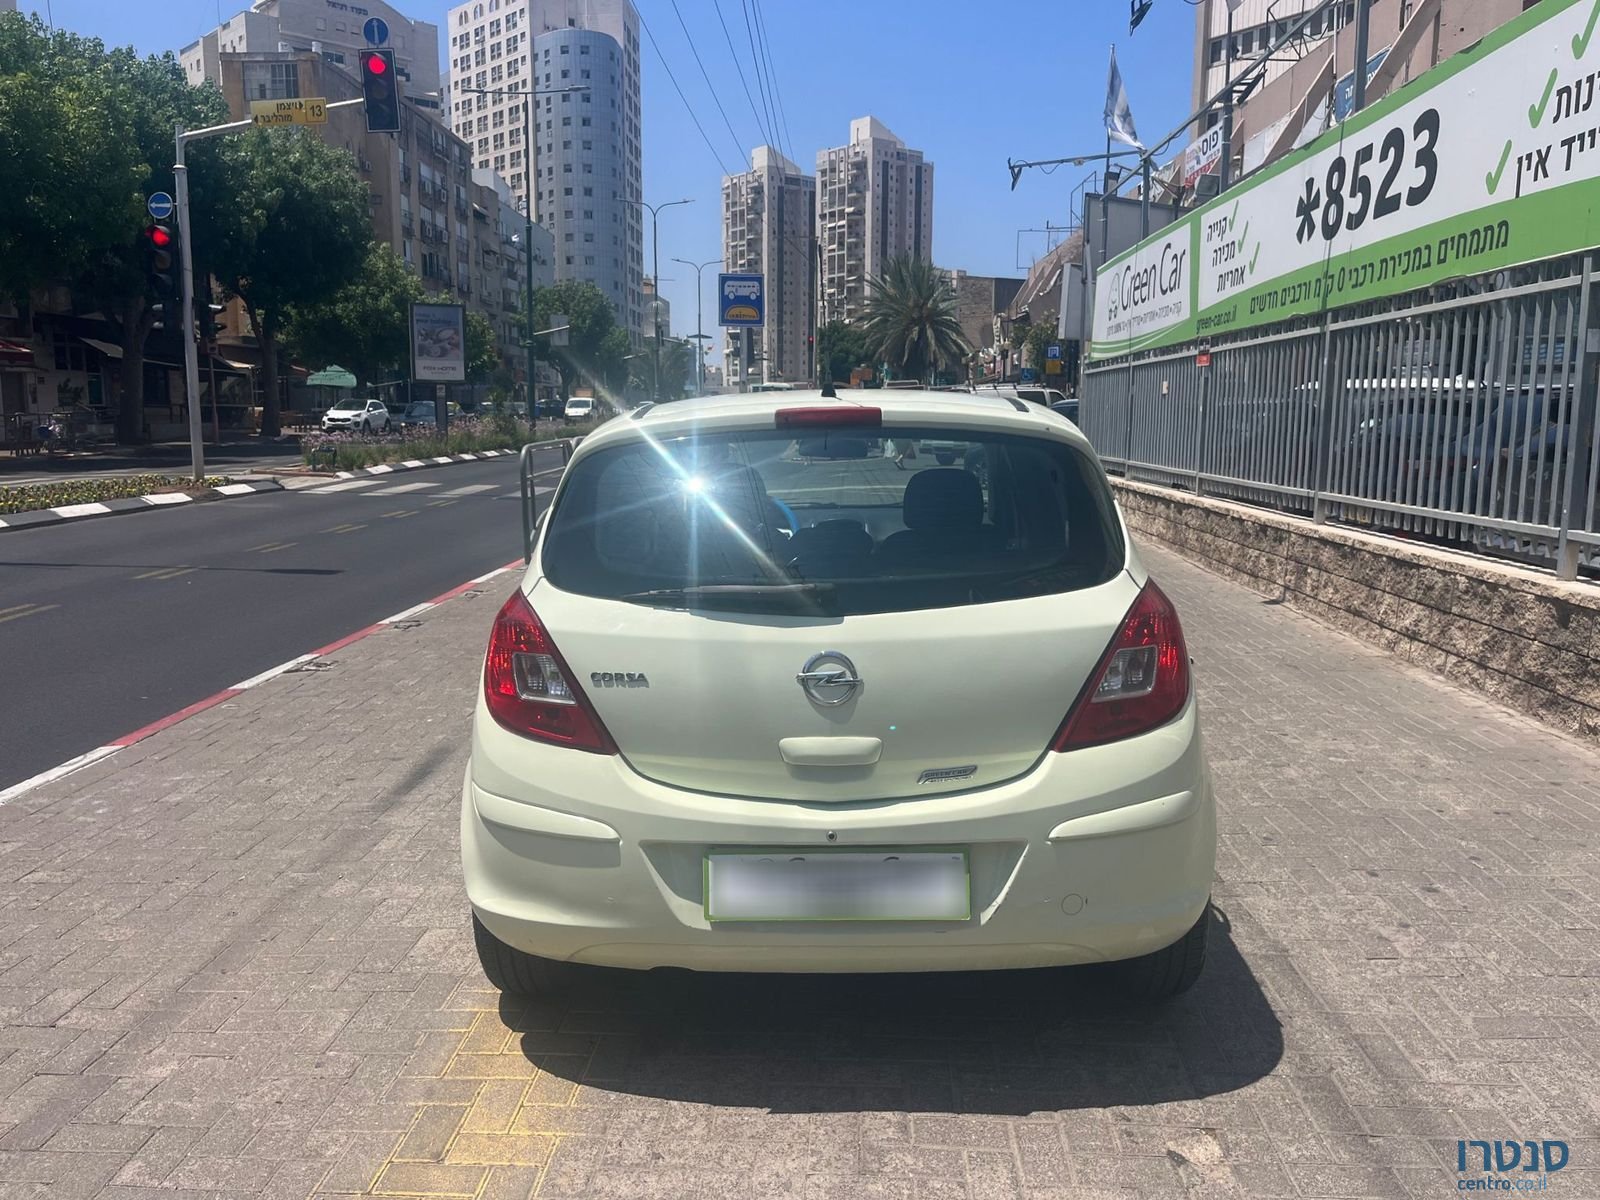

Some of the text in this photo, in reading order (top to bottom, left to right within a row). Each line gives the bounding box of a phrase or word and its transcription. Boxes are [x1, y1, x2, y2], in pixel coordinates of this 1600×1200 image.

[276, 101, 299, 113] ויצמן
[309, 104, 323, 117] 13
[1552, 71, 1600, 124] נות
[260, 112, 293, 123] מוהליבר
[1201, 126, 1223, 156] פוס
[1515, 126, 1600, 199] ייד אין
[1206, 216, 1228, 243] קנייה
[1437, 219, 1509, 265] מתמחים
[1212, 240, 1236, 267] מכירה
[1377, 243, 1432, 282] במכירת
[1121, 242, 1186, 311] Green Car
[1217, 264, 1246, 293] אחריות
[1337, 266, 1346, 292] 0
[1348, 262, 1375, 289] רכבי
[1250, 290, 1278, 315] חדשים
[1280, 281, 1311, 307] ורכבים
[1196, 304, 1238, 335] green-car.co.il
[590, 672, 650, 686] CORSA
